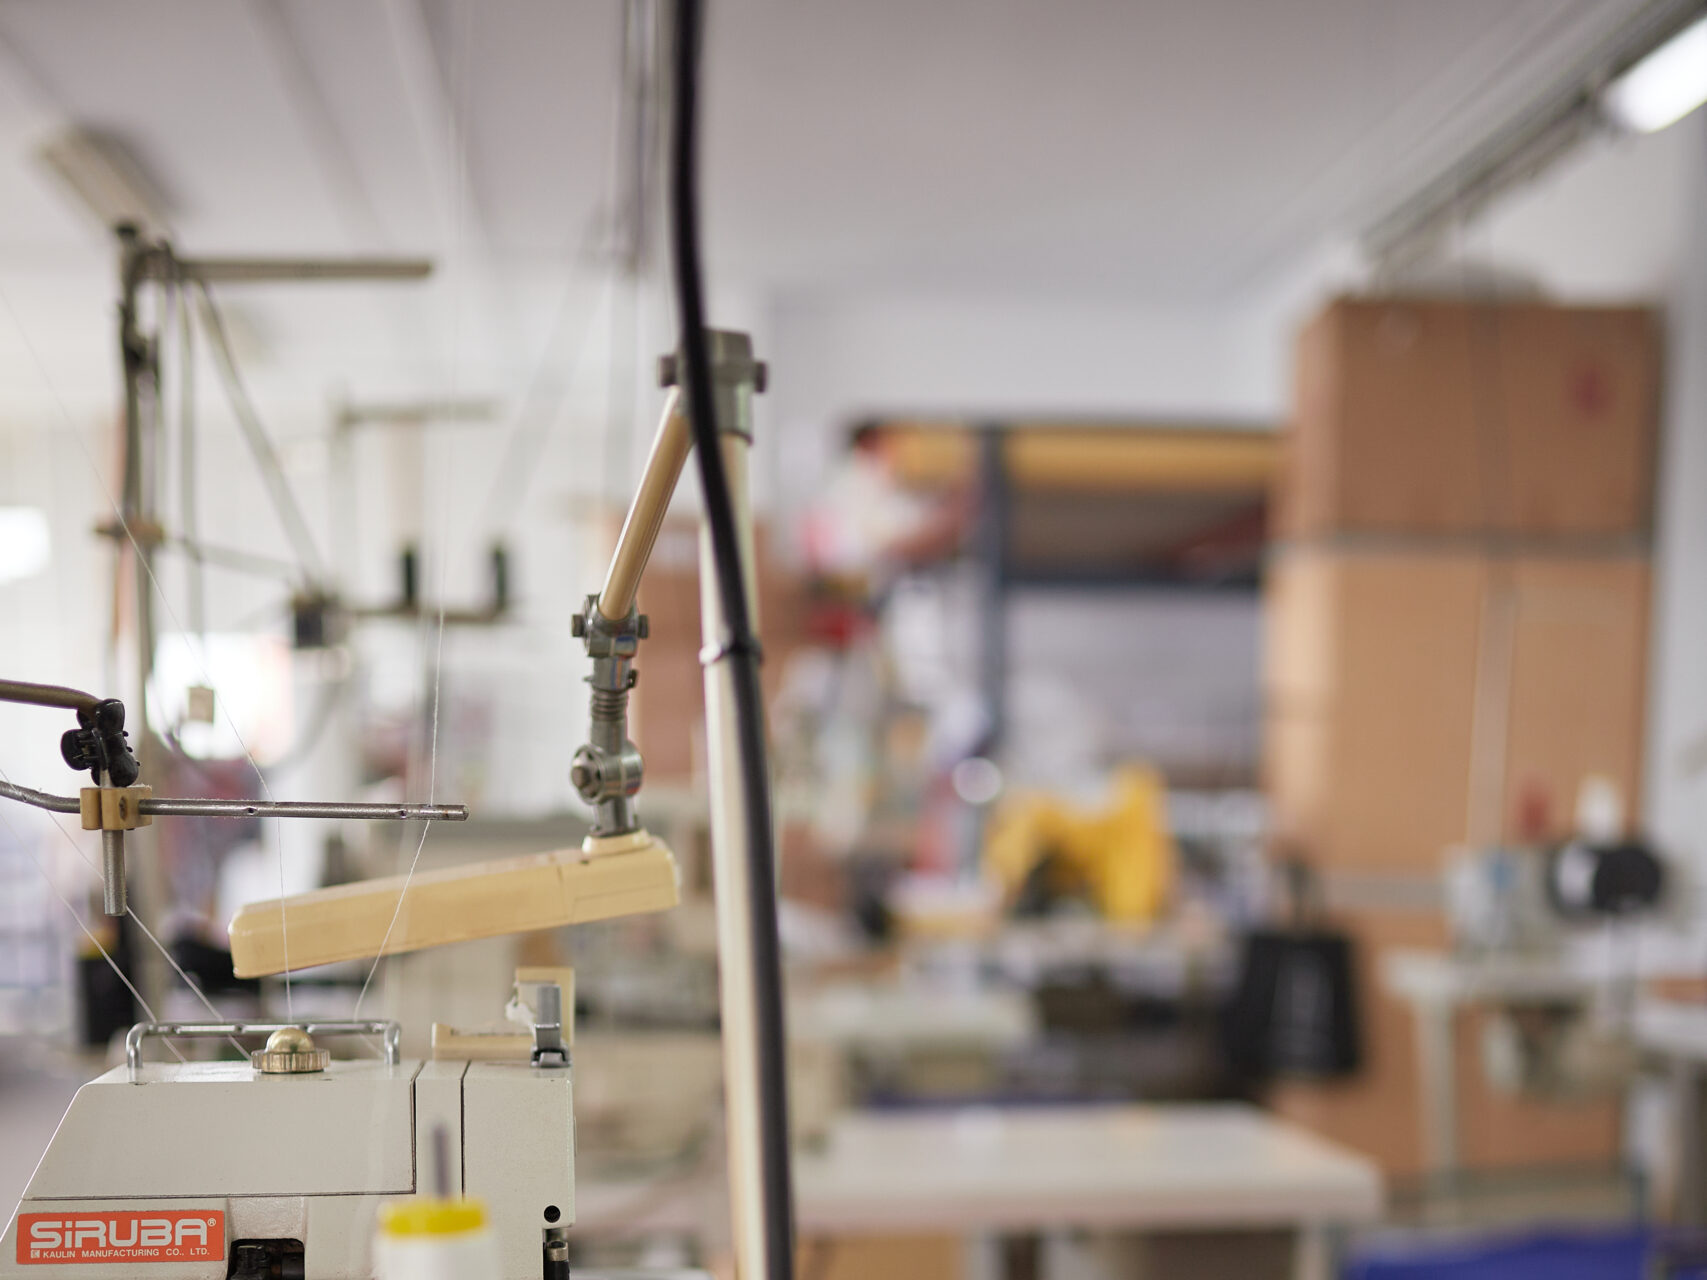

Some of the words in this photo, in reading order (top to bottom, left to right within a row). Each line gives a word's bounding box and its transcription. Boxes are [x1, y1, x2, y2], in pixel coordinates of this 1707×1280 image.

[43, 1250, 75, 1259] KAULIN
[81, 1248, 160, 1258] MANUFACTURING
[189, 1247, 210, 1256] LTD.
